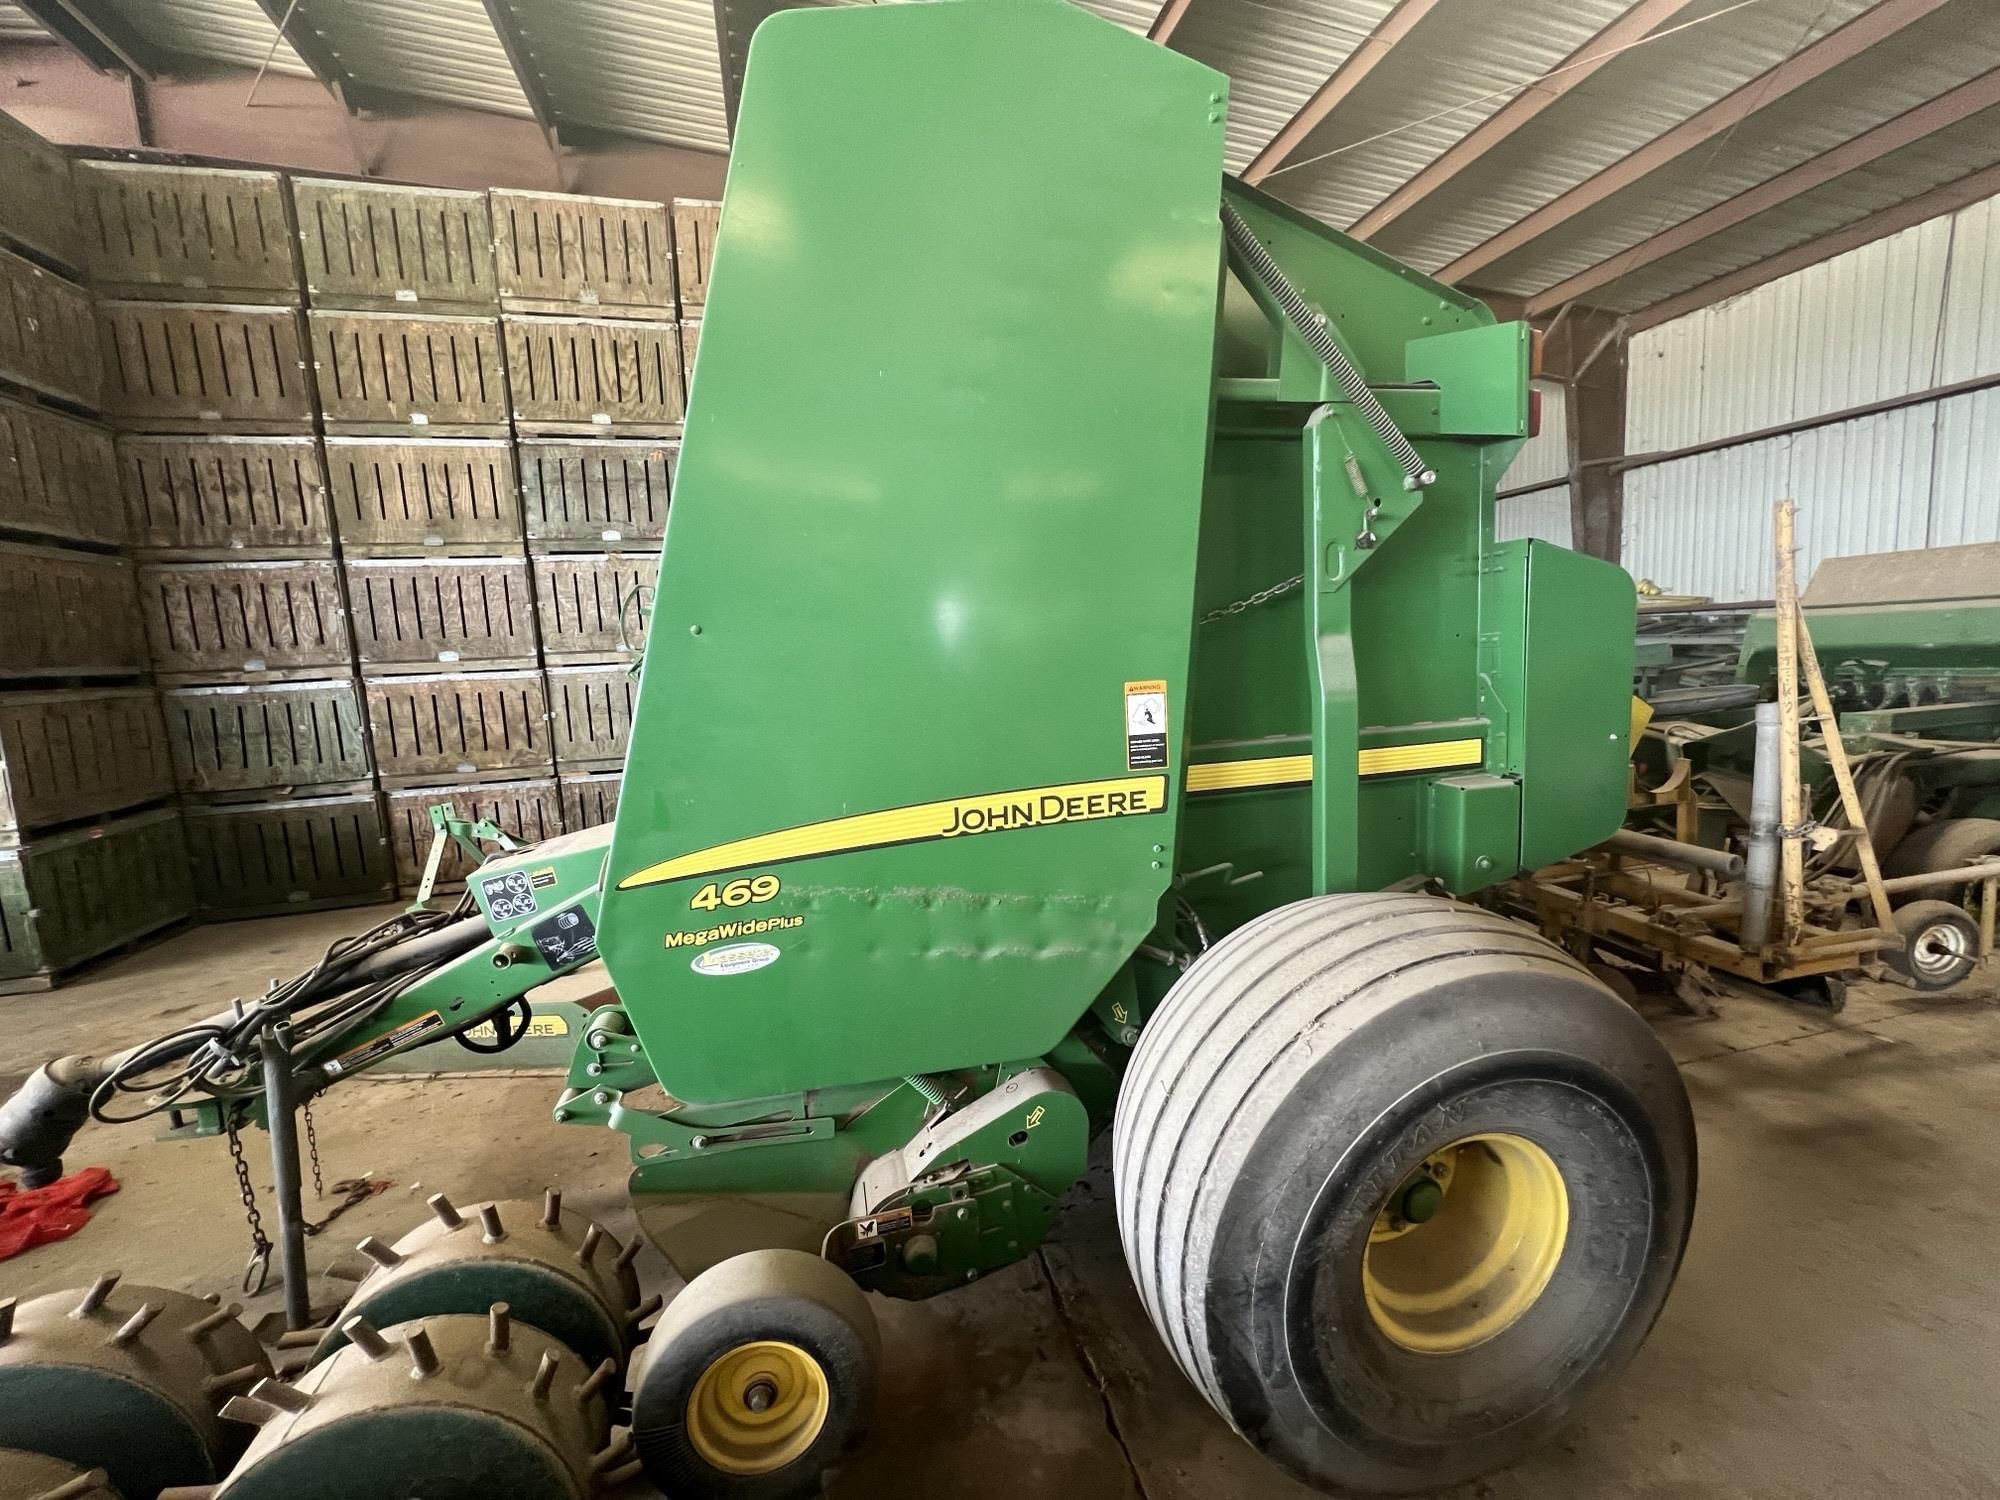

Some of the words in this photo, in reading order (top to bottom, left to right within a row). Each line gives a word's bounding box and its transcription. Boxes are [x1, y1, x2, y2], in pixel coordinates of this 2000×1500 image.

[942, 802, 1033, 833] JOHN
[1040, 790, 1147, 821] DEERE
[690, 875, 781, 911] 469
[665, 916, 805, 949] MegaWidePlus
